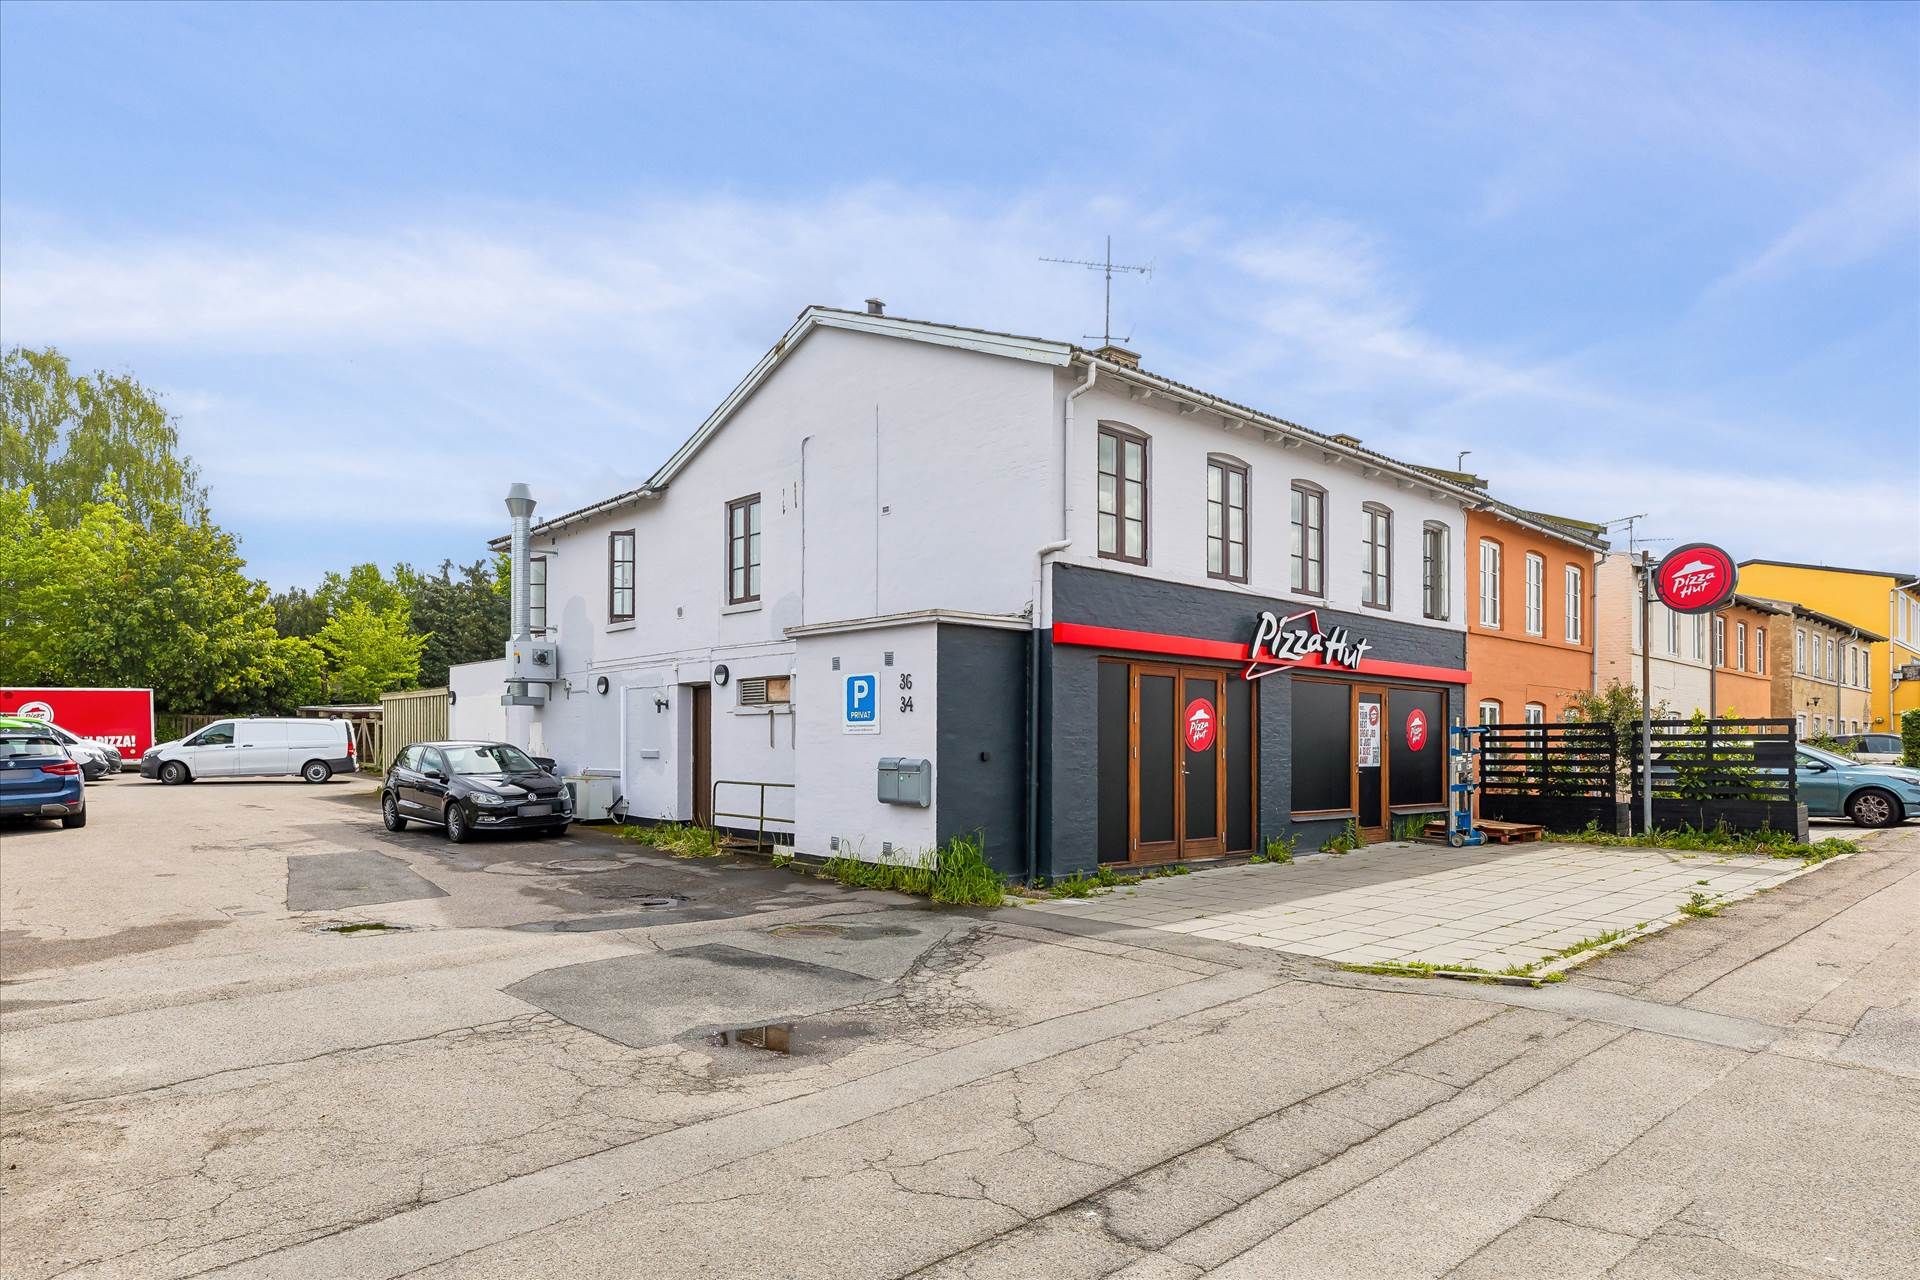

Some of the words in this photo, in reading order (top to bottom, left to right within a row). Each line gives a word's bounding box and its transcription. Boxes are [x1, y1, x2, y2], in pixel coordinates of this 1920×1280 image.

[1673, 572, 1715, 593] Pizza
[1680, 581, 1710, 598] Hut
[1251, 611, 1323, 660] Pizza
[1324, 626, 1373, 669] Hut
[900, 673, 912, 690] 36
[854, 680, 868, 708] P
[900, 696, 913, 713] 34
[850, 711, 871, 719] PRIVAT
[1190, 720, 1209, 735] Pizza
[1193, 729, 1208, 743] Hut
